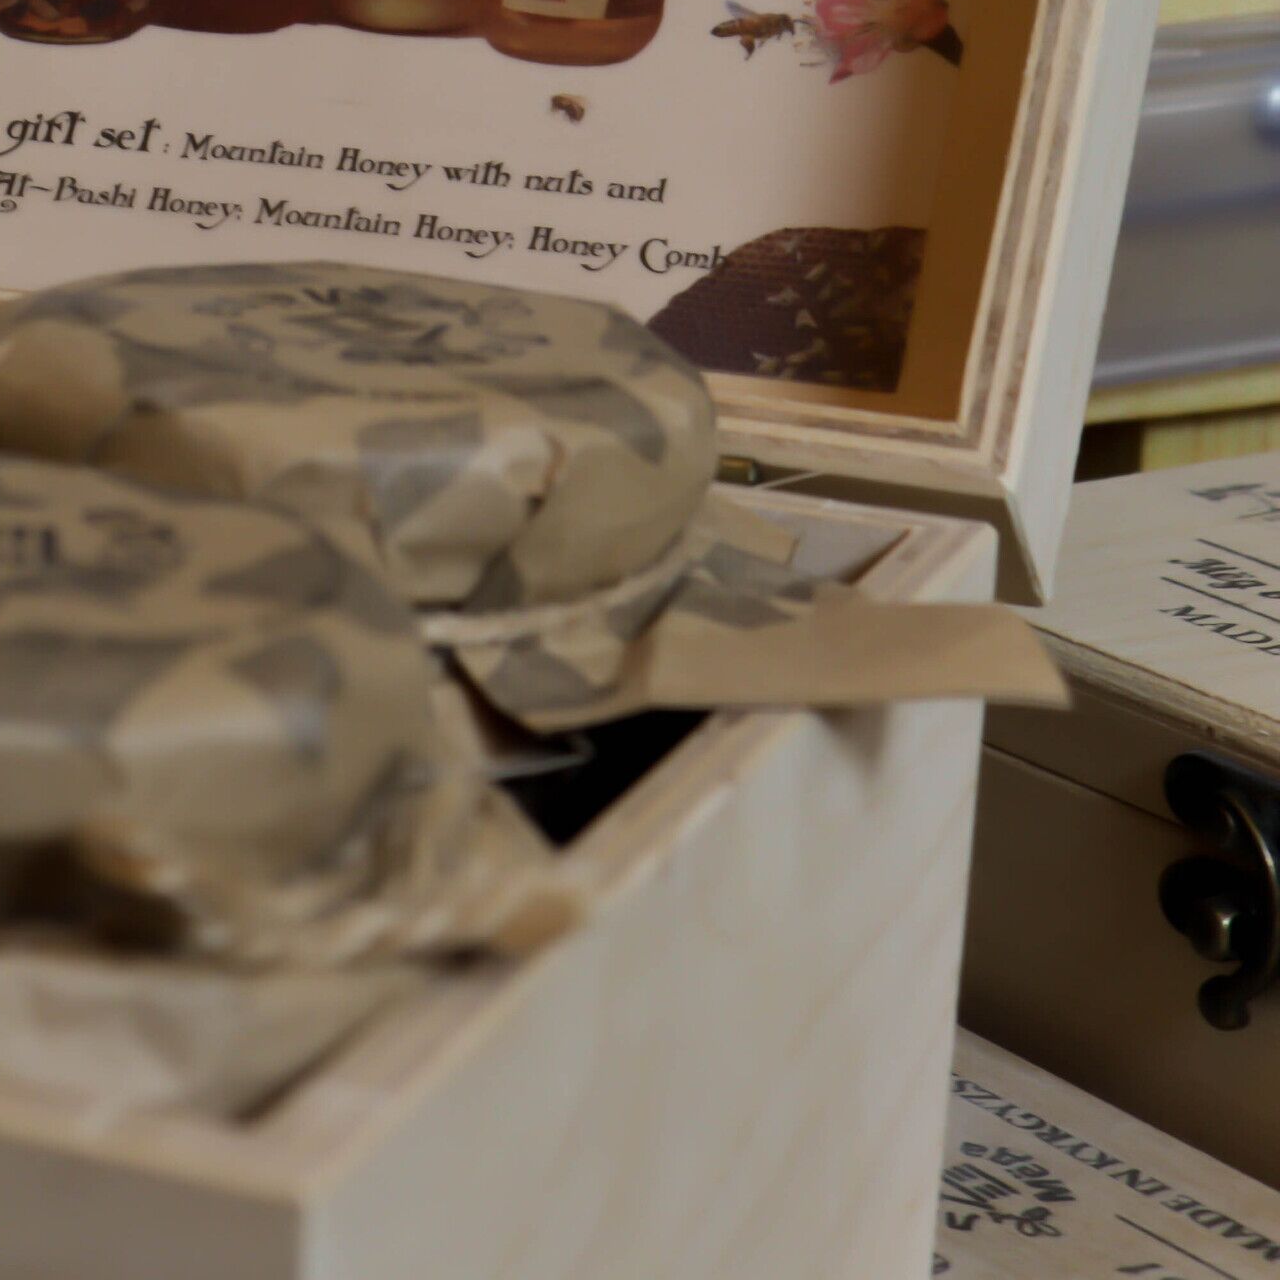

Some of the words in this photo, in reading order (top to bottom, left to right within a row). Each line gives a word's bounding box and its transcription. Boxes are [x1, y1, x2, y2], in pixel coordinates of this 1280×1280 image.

[179, 131, 326, 170] Mountain
[336, 145, 433, 192] Honey
[442, 160, 513, 188] with
[524, 168, 594, 197] nuts
[606, 177, 669, 206] and
[253, 196, 402, 237] Mountain
[526, 225, 630, 272] Honey
[1113, 1167, 1170, 1196] IN
